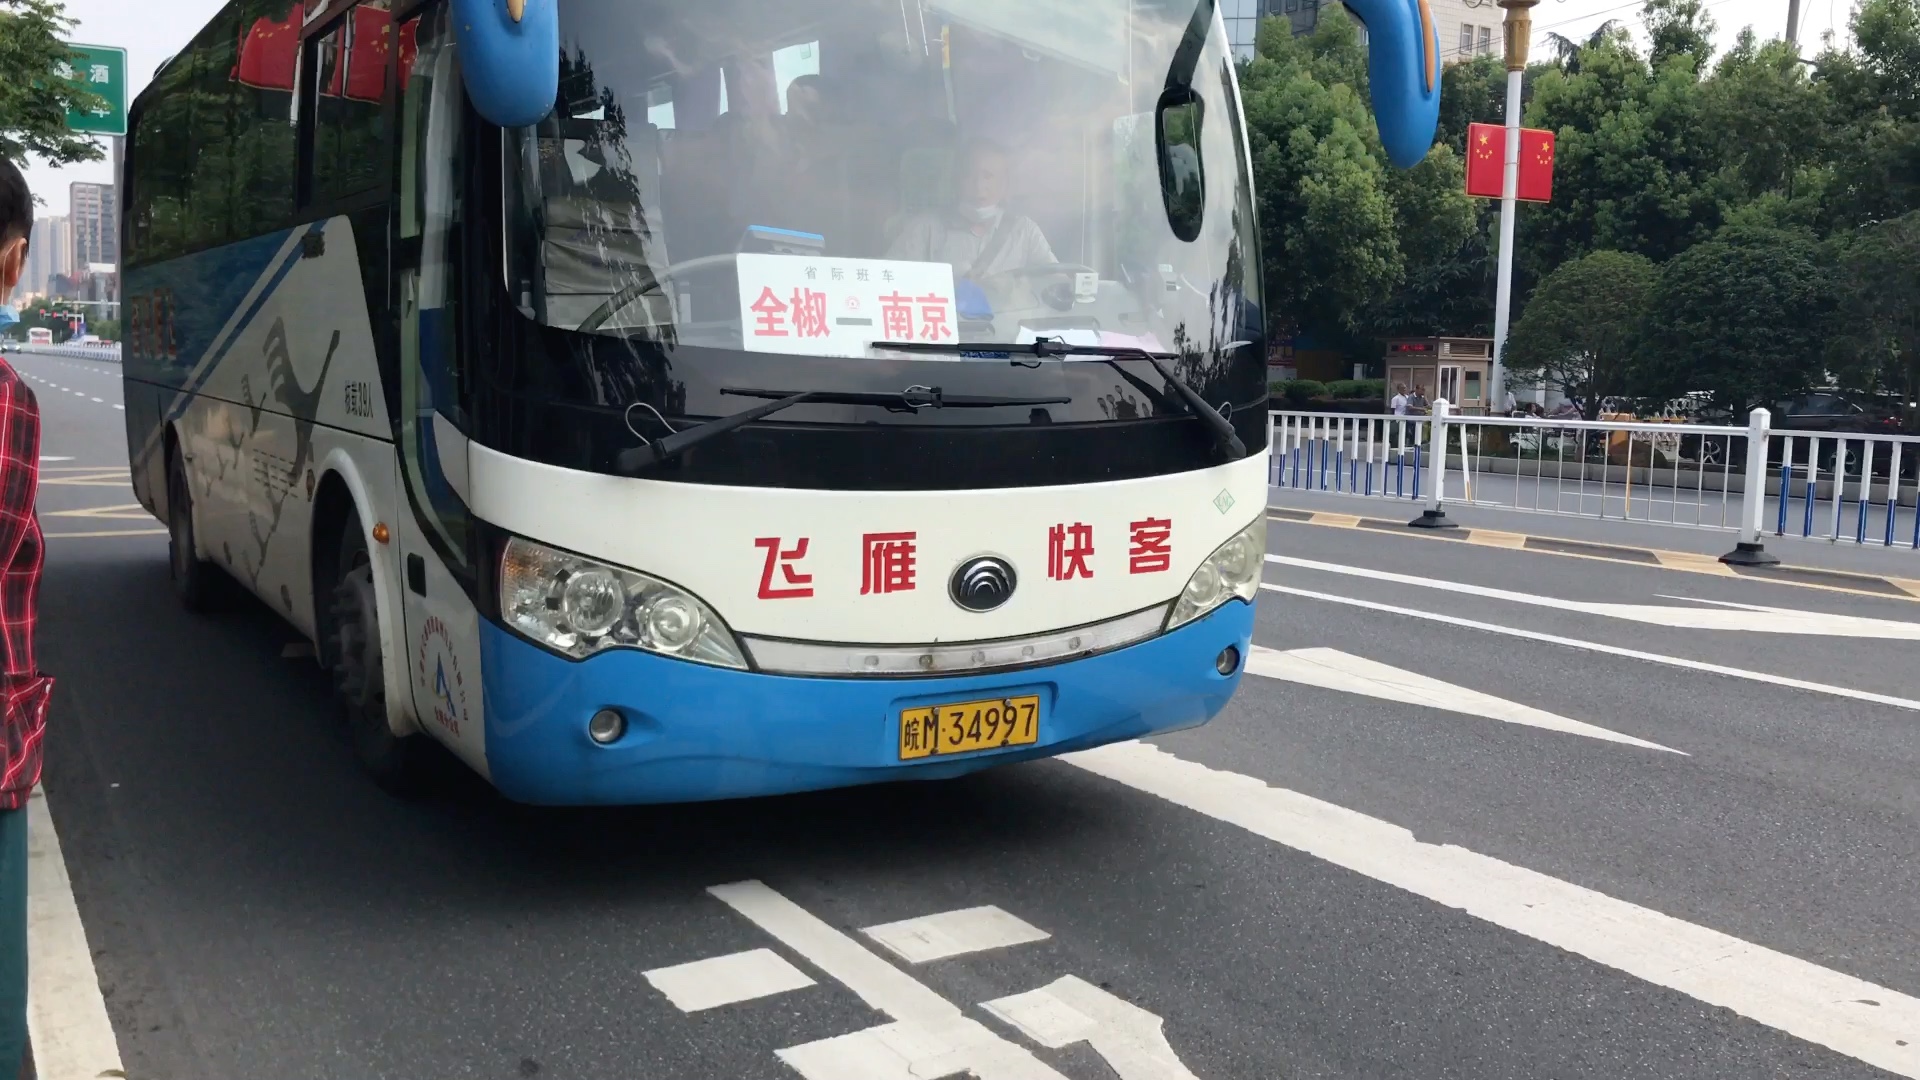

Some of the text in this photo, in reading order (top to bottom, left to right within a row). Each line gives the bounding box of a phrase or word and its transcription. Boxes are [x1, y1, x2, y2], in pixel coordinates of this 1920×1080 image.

[804, 266, 895, 283] 省际班车
[750, 286, 952, 341] 全椒 南京
[345, 380, 373, 418] 核载39人
[755, 517, 1171, 599] 飞雁 快客
